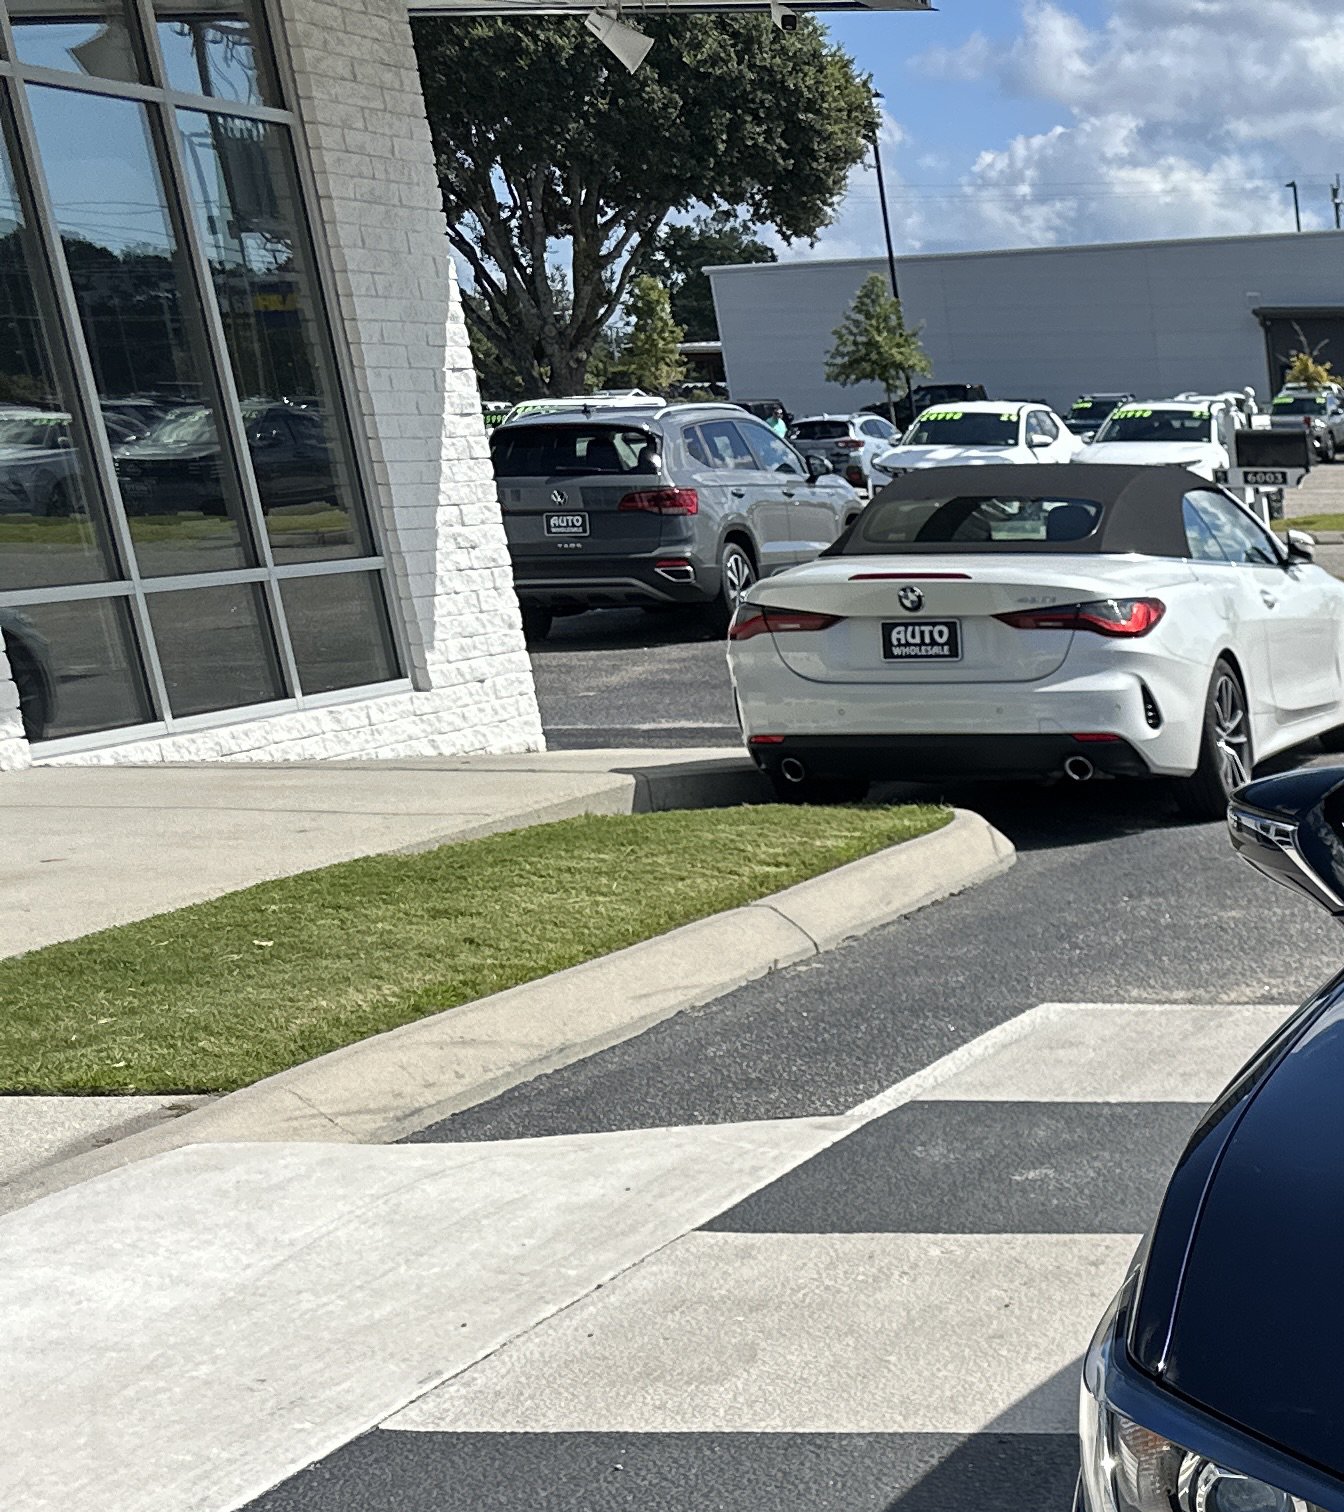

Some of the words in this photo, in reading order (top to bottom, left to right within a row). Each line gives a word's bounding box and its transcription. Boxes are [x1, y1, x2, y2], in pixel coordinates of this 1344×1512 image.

[1247, 472, 1284, 484] 6003
[550, 515, 583, 527] AUTO
[890, 625, 950, 646] AUTO
[891, 645, 951, 656] WHOLESALE
